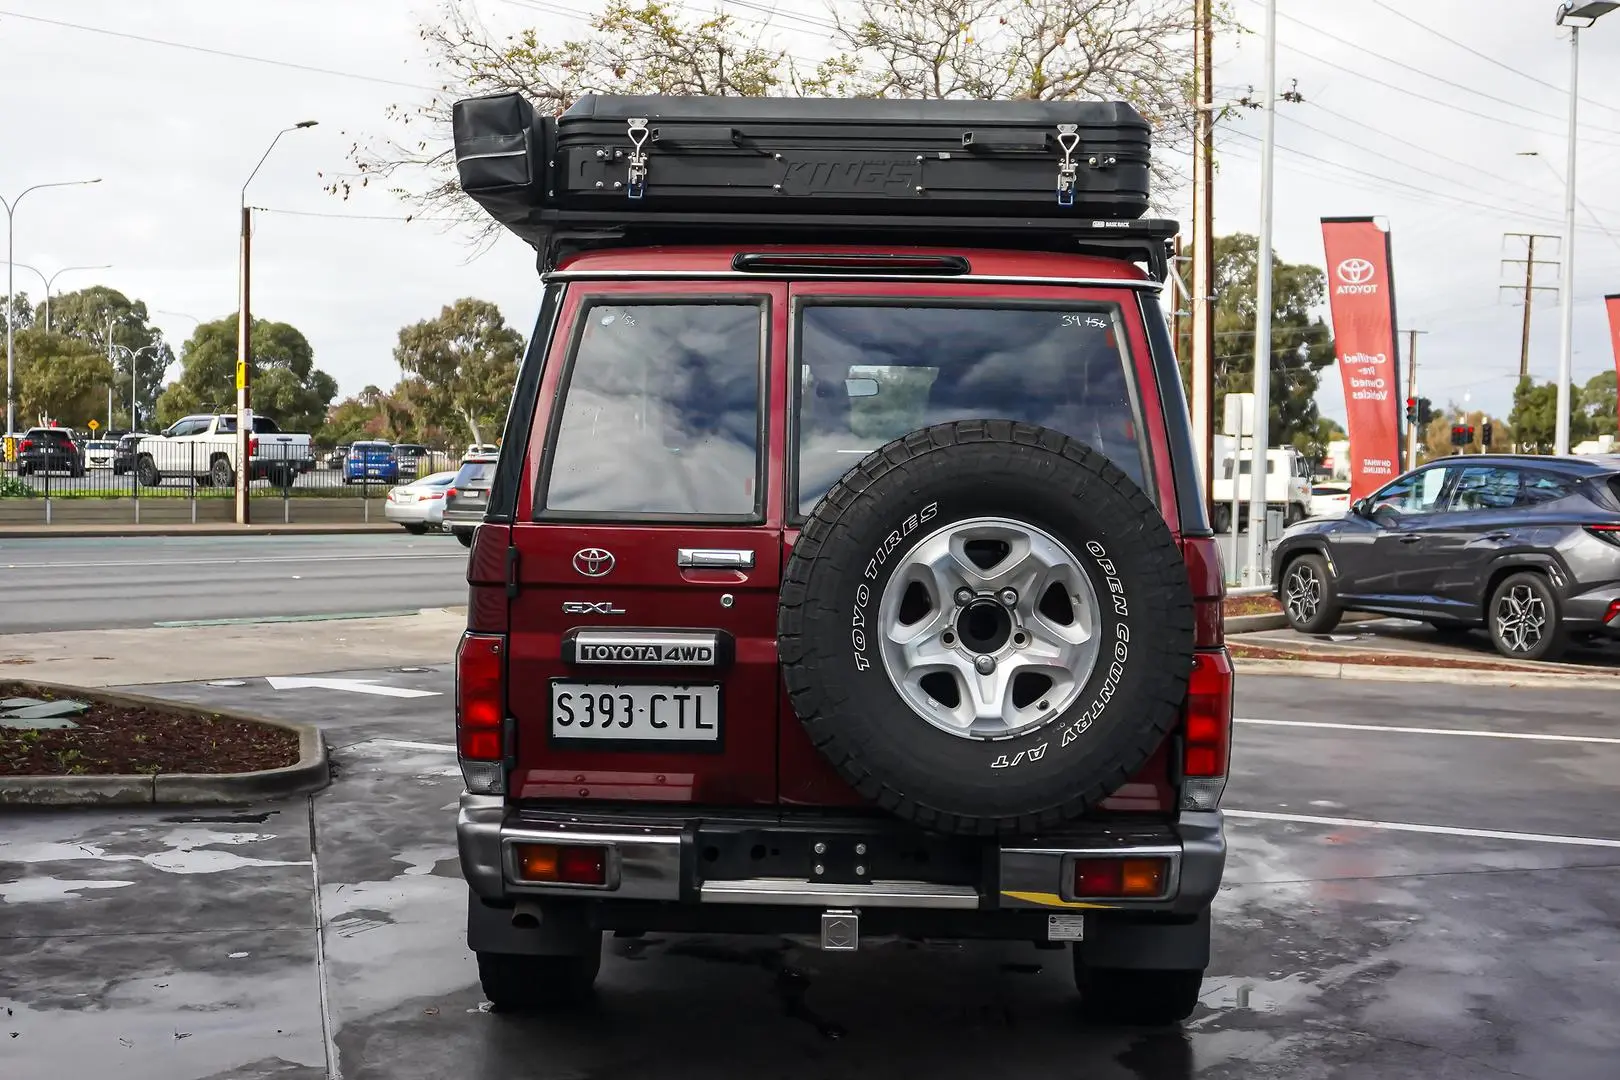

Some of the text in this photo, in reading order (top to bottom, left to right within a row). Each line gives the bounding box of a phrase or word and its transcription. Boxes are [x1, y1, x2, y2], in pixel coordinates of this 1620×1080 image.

[781, 160, 917, 187] KINGS
[852, 502, 938, 671] TOYO TIRES
[562, 602, 626, 613] GXL
[585, 646, 712, 661] TOYOTA 4WD
[991, 541, 1130, 768] OPEN COUNTRY A/T
